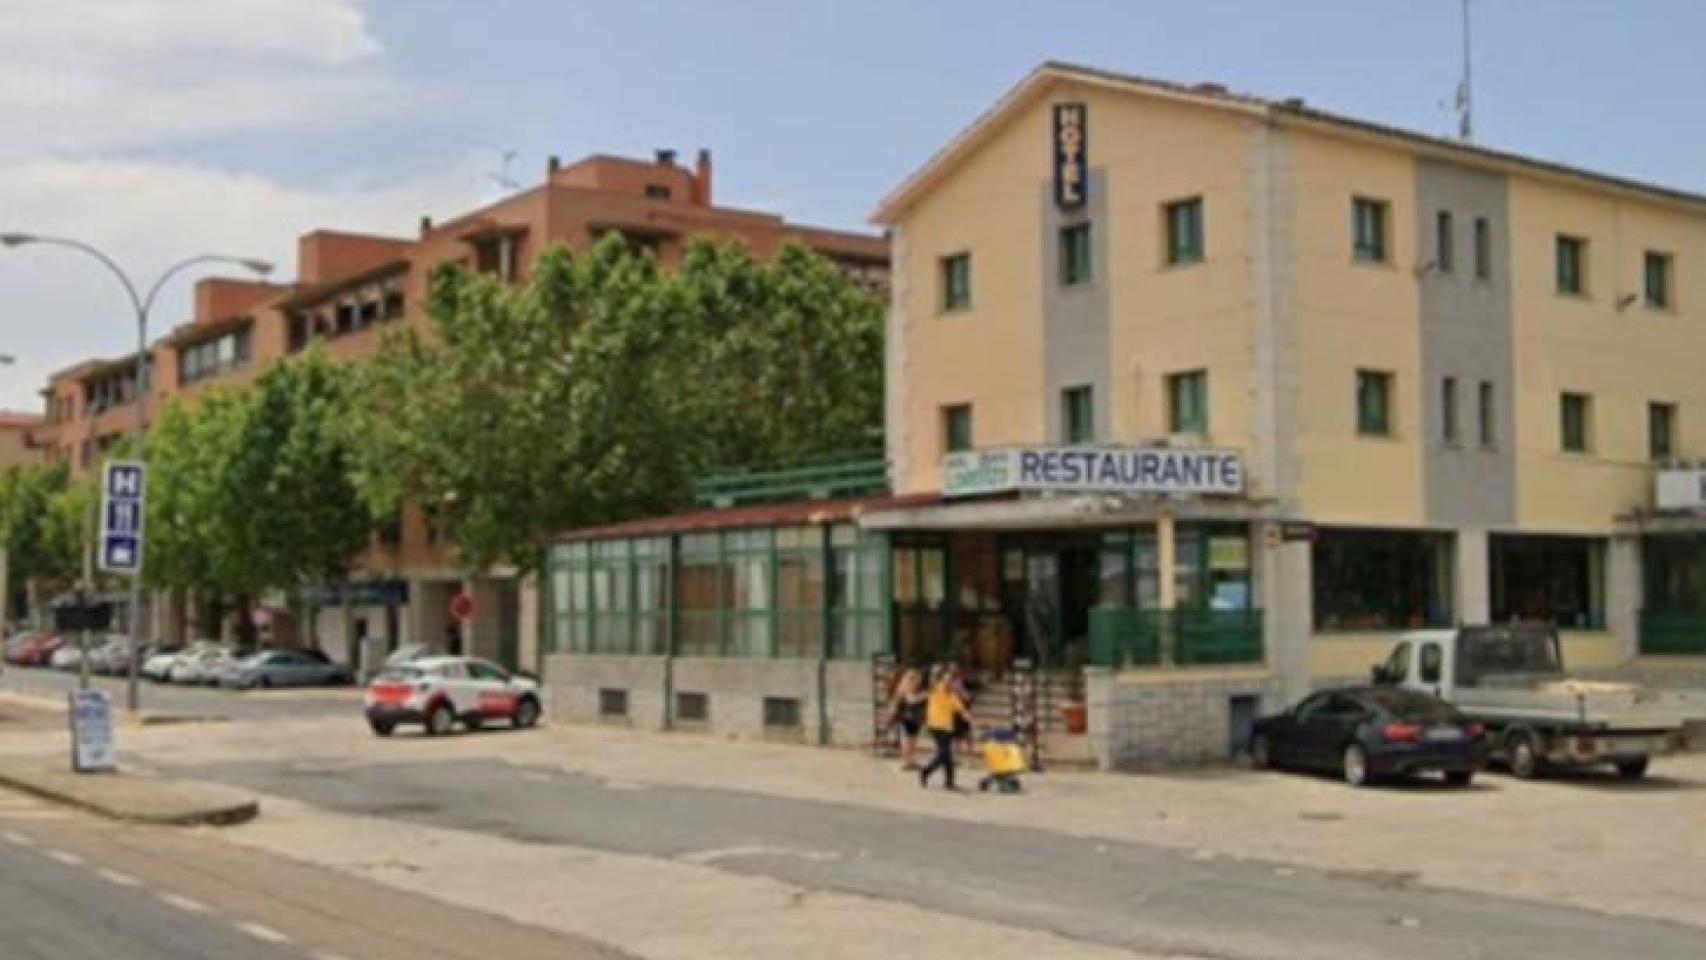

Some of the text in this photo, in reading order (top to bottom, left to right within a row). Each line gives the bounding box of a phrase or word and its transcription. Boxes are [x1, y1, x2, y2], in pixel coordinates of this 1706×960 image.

[1060, 105, 1081, 202] HOTEL
[112, 470, 136, 495] H
[1020, 451, 1239, 486] RESTAURANTE
